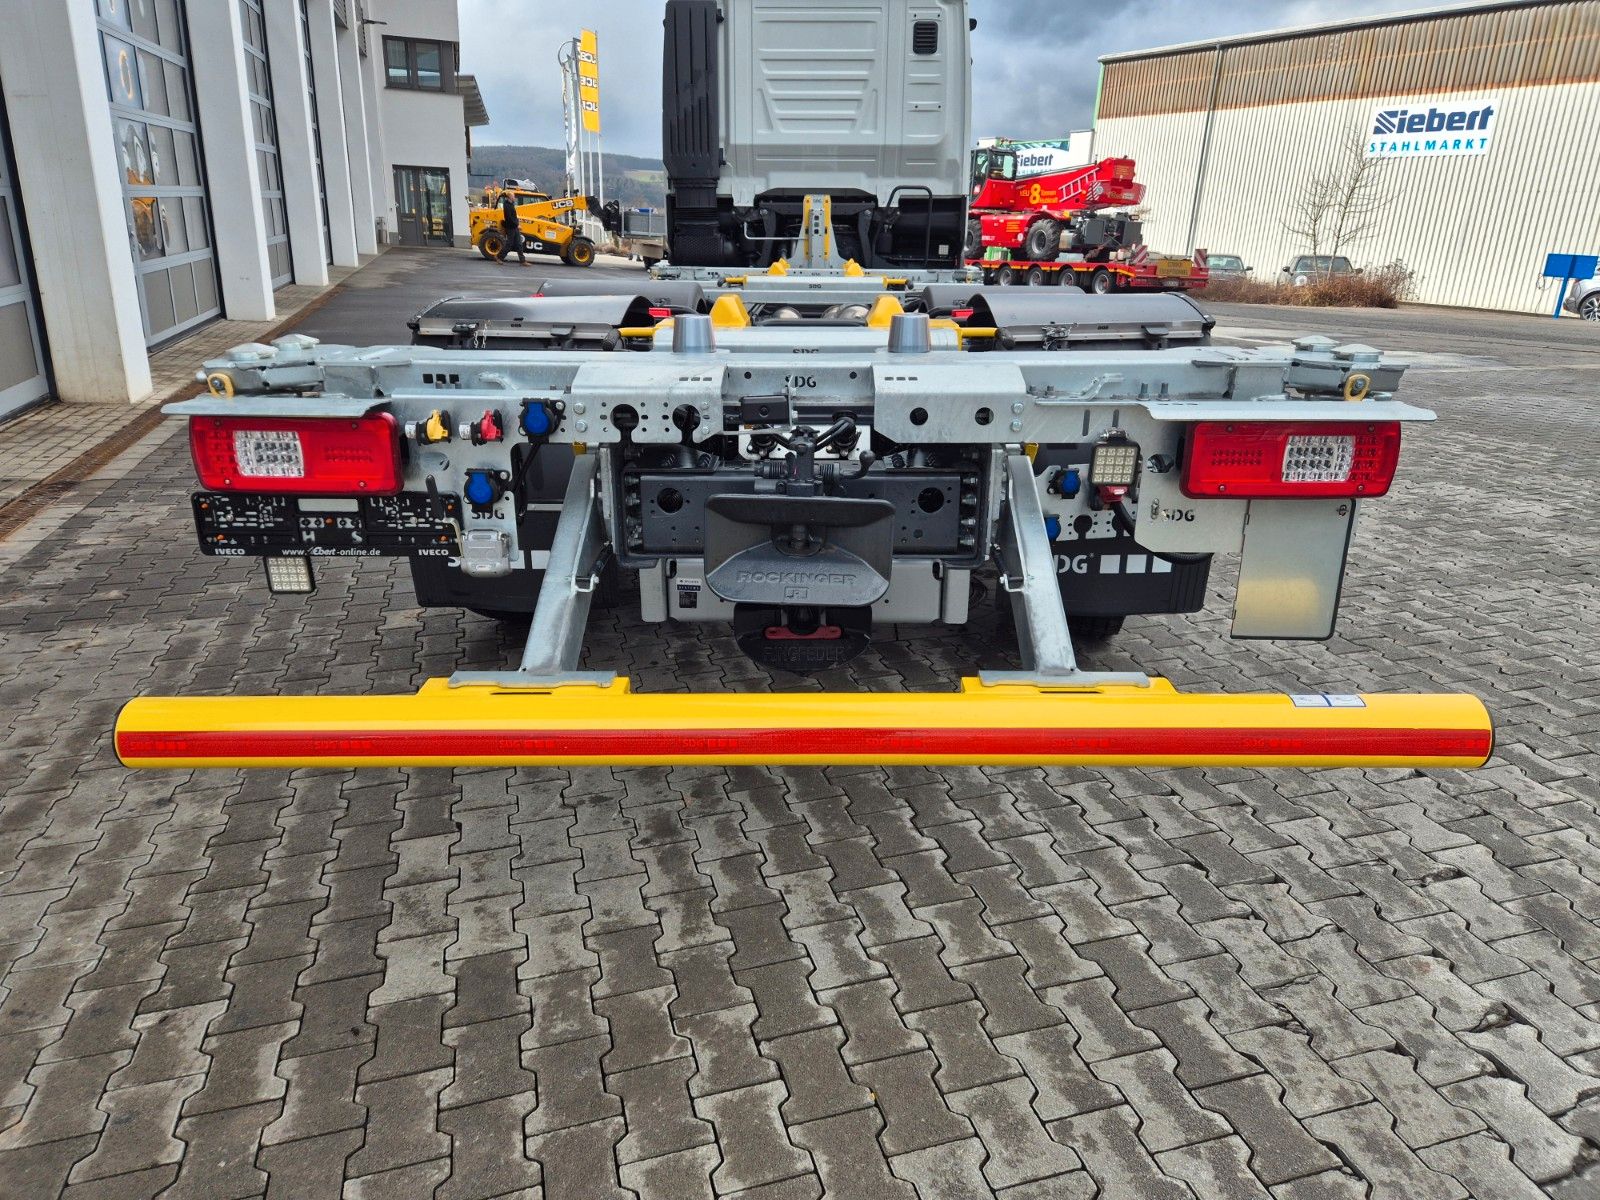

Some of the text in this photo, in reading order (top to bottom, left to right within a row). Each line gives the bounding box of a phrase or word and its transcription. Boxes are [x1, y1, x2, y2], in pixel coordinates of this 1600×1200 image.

[1373, 105, 1494, 134] Siebert
[1369, 138, 1488, 152] STAHLMARKT
[1029, 183, 1041, 204] 8
[552, 199, 574, 209] JCB
[418, 548, 449, 556] IVECO
[736, 570, 857, 585] ROCKINGER
